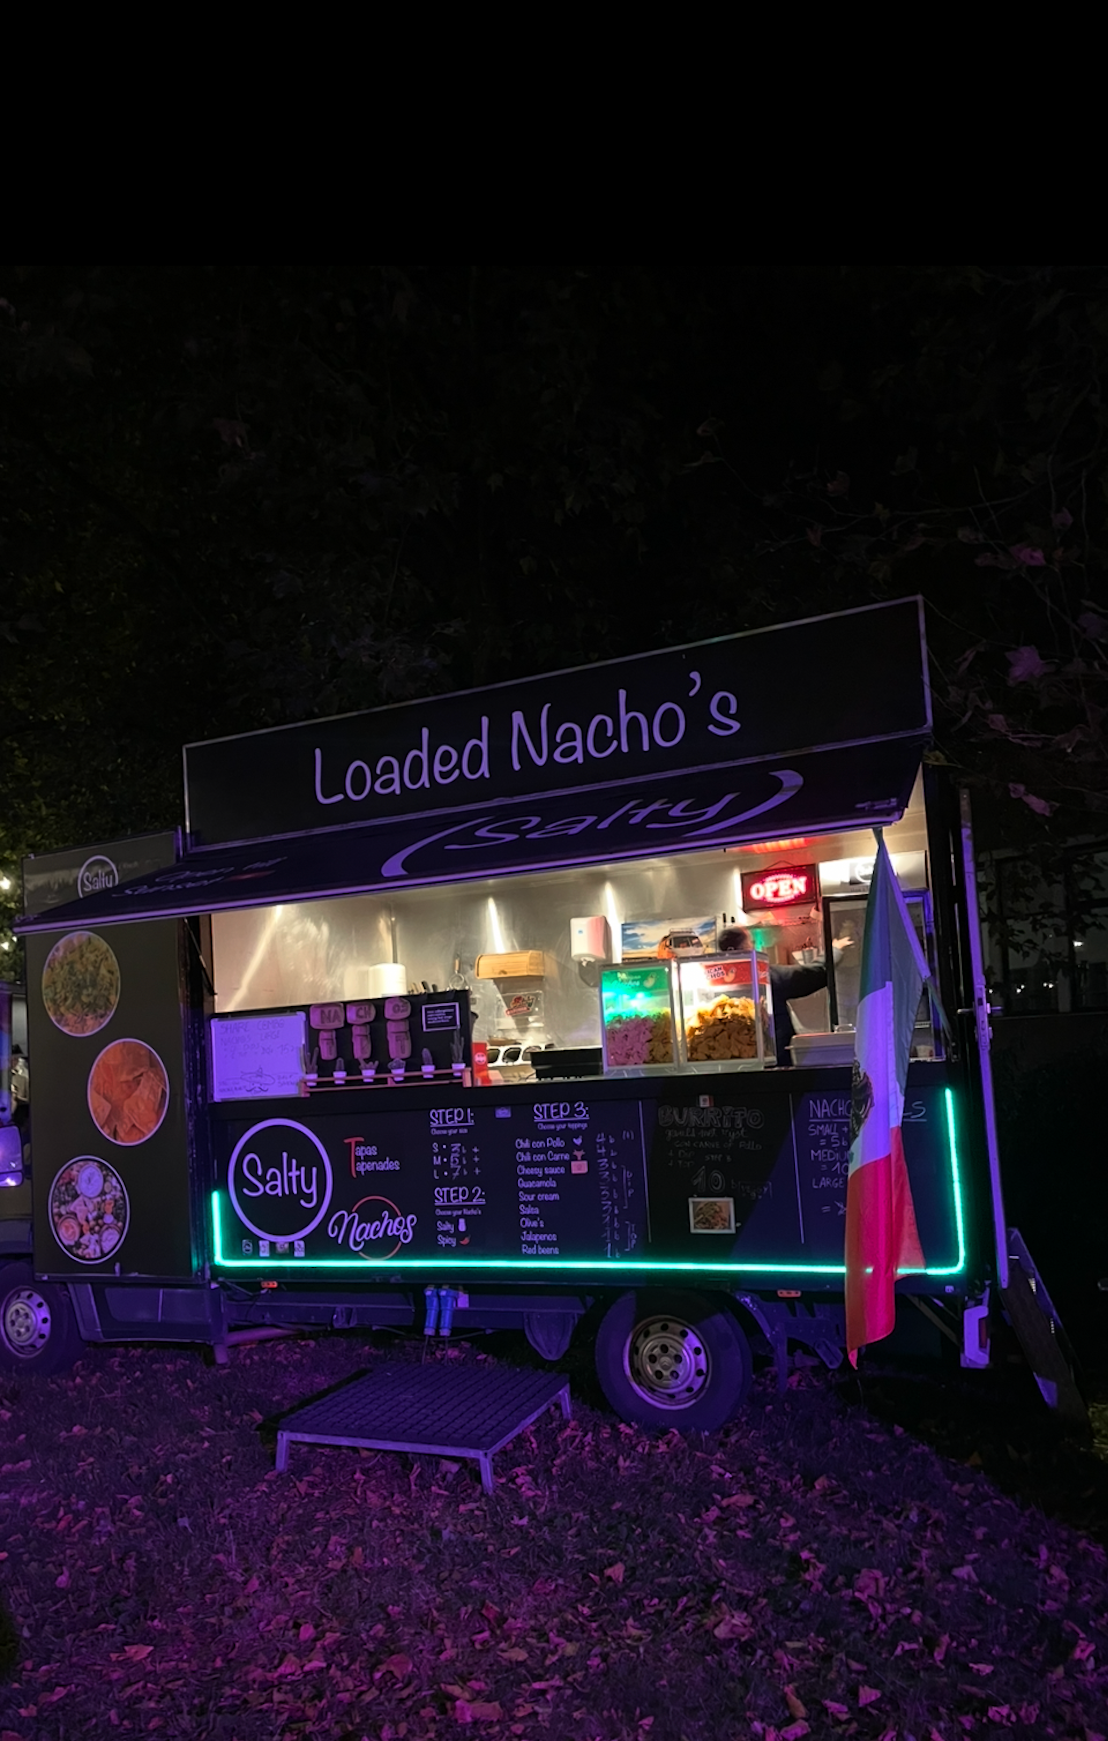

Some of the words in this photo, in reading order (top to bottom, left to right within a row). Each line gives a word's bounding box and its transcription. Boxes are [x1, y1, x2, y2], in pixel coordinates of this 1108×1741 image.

[313, 714, 491, 805] Loaded
[509, 670, 742, 772] Nacho's
[444, 788, 742, 850] Salty
[751, 877, 806, 899] OPEN
[430, 1108, 464, 1125] STEP
[467, 1108, 475, 1124] 1:
[533, 1103, 570, 1120] STEP
[574, 1101, 590, 1119] 3:
[555, 1123, 567, 1131] your
[808, 1123, 838, 1136] SMALL
[432, 1142, 439, 1153] S
[515, 1138, 531, 1149] Chili
[531, 1140, 546, 1149] con
[546, 1136, 565, 1148] Pollo
[433, 1155, 441, 1166] M
[516, 1151, 531, 1162] Chili
[532, 1153, 547, 1162] con
[547, 1150, 570, 1162] Carne
[433, 1169, 440, 1180] L
[517, 1164, 543, 1177] Cheesy
[544, 1166, 566, 1175] sauce
[242, 1151, 319, 1210] Salty
[691, 1165, 726, 1193] 10
[812, 1177, 844, 1189] LARGE
[434, 1187, 469, 1203] STEP
[471, 1186, 486, 1203] 2:
[518, 1190, 536, 1202] Sour
[537, 1193, 560, 1202] cream
[452, 1208, 463, 1217] your
[519, 1203, 540, 1215] Salsa
[436, 1220, 455, 1234] Salty
[520, 1216, 545, 1228] Olive's
[327, 1209, 417, 1251] Nachos
[437, 1234, 457, 1247] Spicy
[520, 1230, 557, 1244] Jalapenos
[521, 1243, 537, 1254] Red
[537, 1244, 560, 1254] beans
